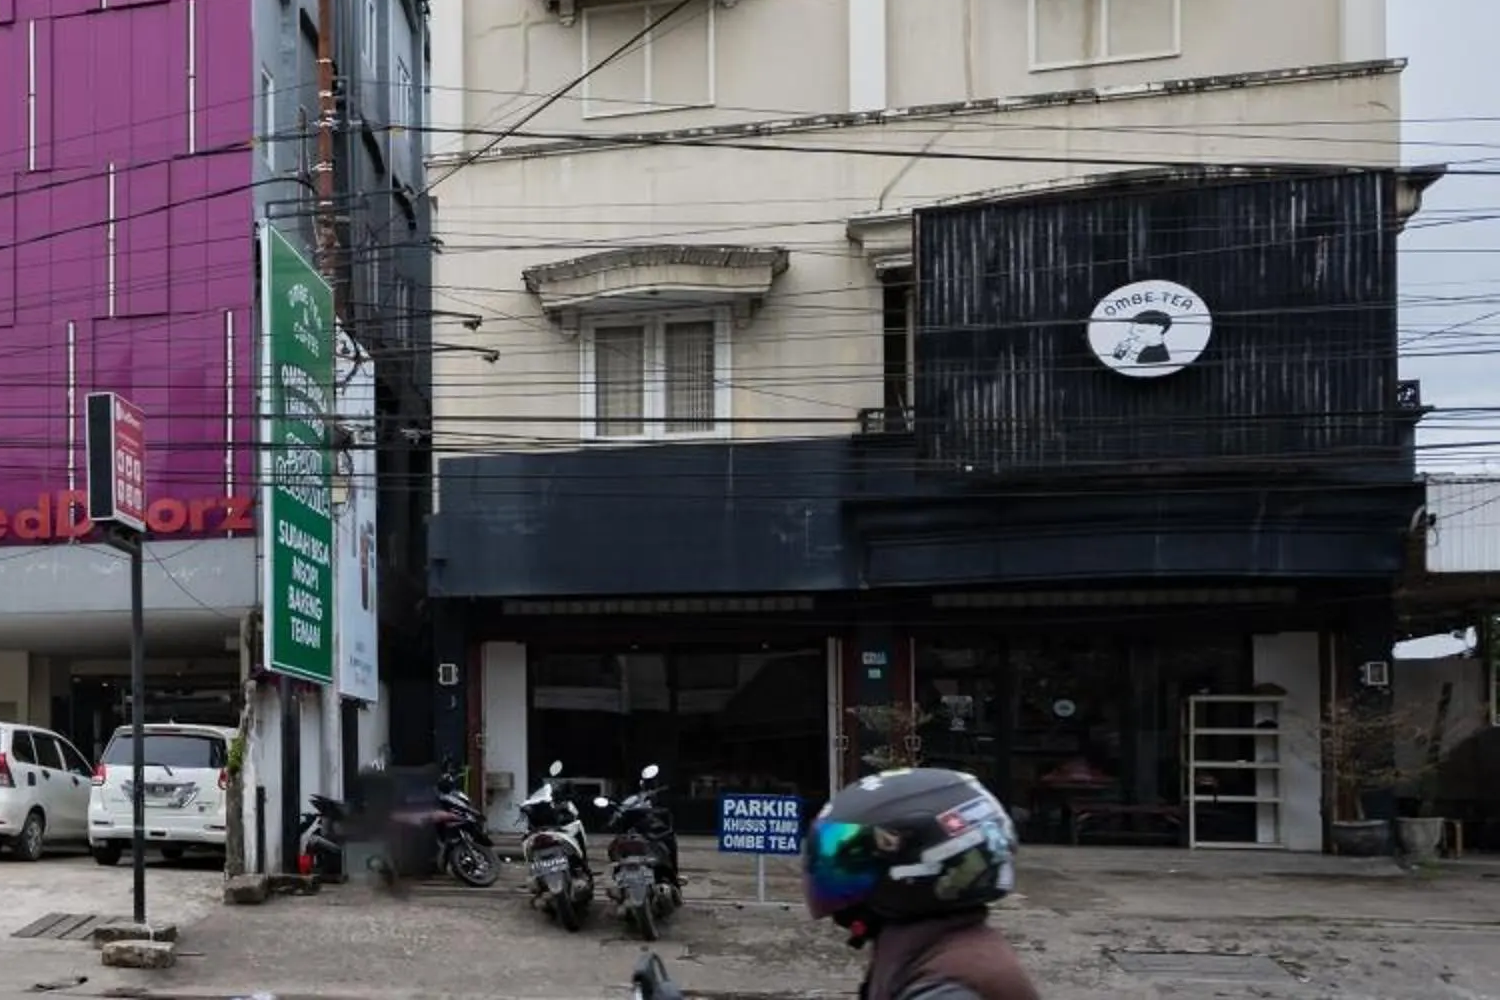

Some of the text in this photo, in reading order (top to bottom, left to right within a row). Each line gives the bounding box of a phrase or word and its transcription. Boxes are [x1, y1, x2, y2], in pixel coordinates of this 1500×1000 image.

[1103, 291, 1193, 316] OMBE TEA
[723, 799, 797, 817] PARKIR
[723, 817, 767, 833] KHUSUS
[723, 834, 797, 850] OMBE TEA
